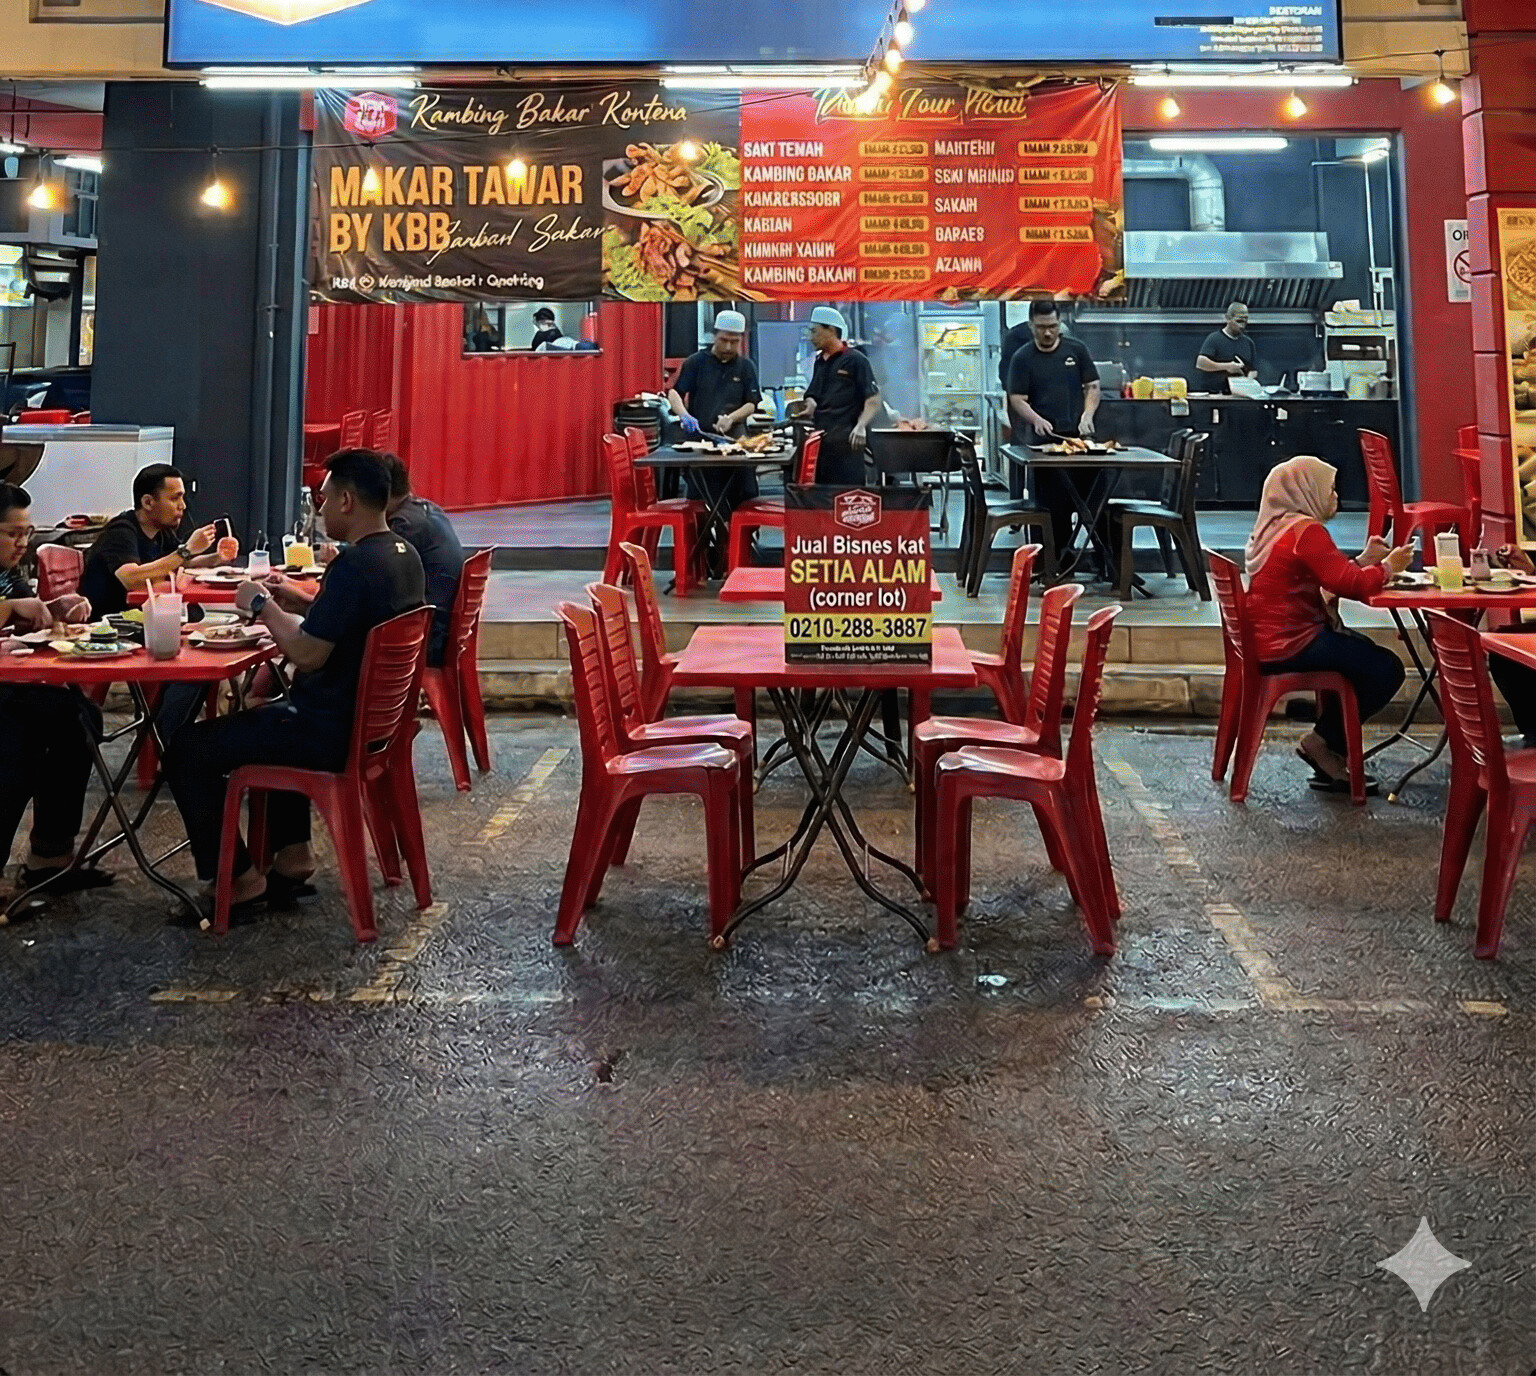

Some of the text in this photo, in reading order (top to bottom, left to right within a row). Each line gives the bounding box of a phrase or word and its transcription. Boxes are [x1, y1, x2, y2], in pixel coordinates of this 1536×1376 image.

[409, 93, 509, 135] Kambing
[516, 92, 592, 130] Bakar
[599, 91, 688, 130] Kontena
[329, 164, 585, 208] MAKAR TAWAR
[743, 165, 805, 182] KAMBING
[329, 211, 452, 253] BY KBB
[744, 267, 805, 284] KAMBING
[790, 535, 926, 555] Jual Bisnes kat
[789, 558, 927, 584] SETIA ALAM
[809, 587, 907, 612] (corner lot)
[789, 617, 928, 639] 0210-288-3887
